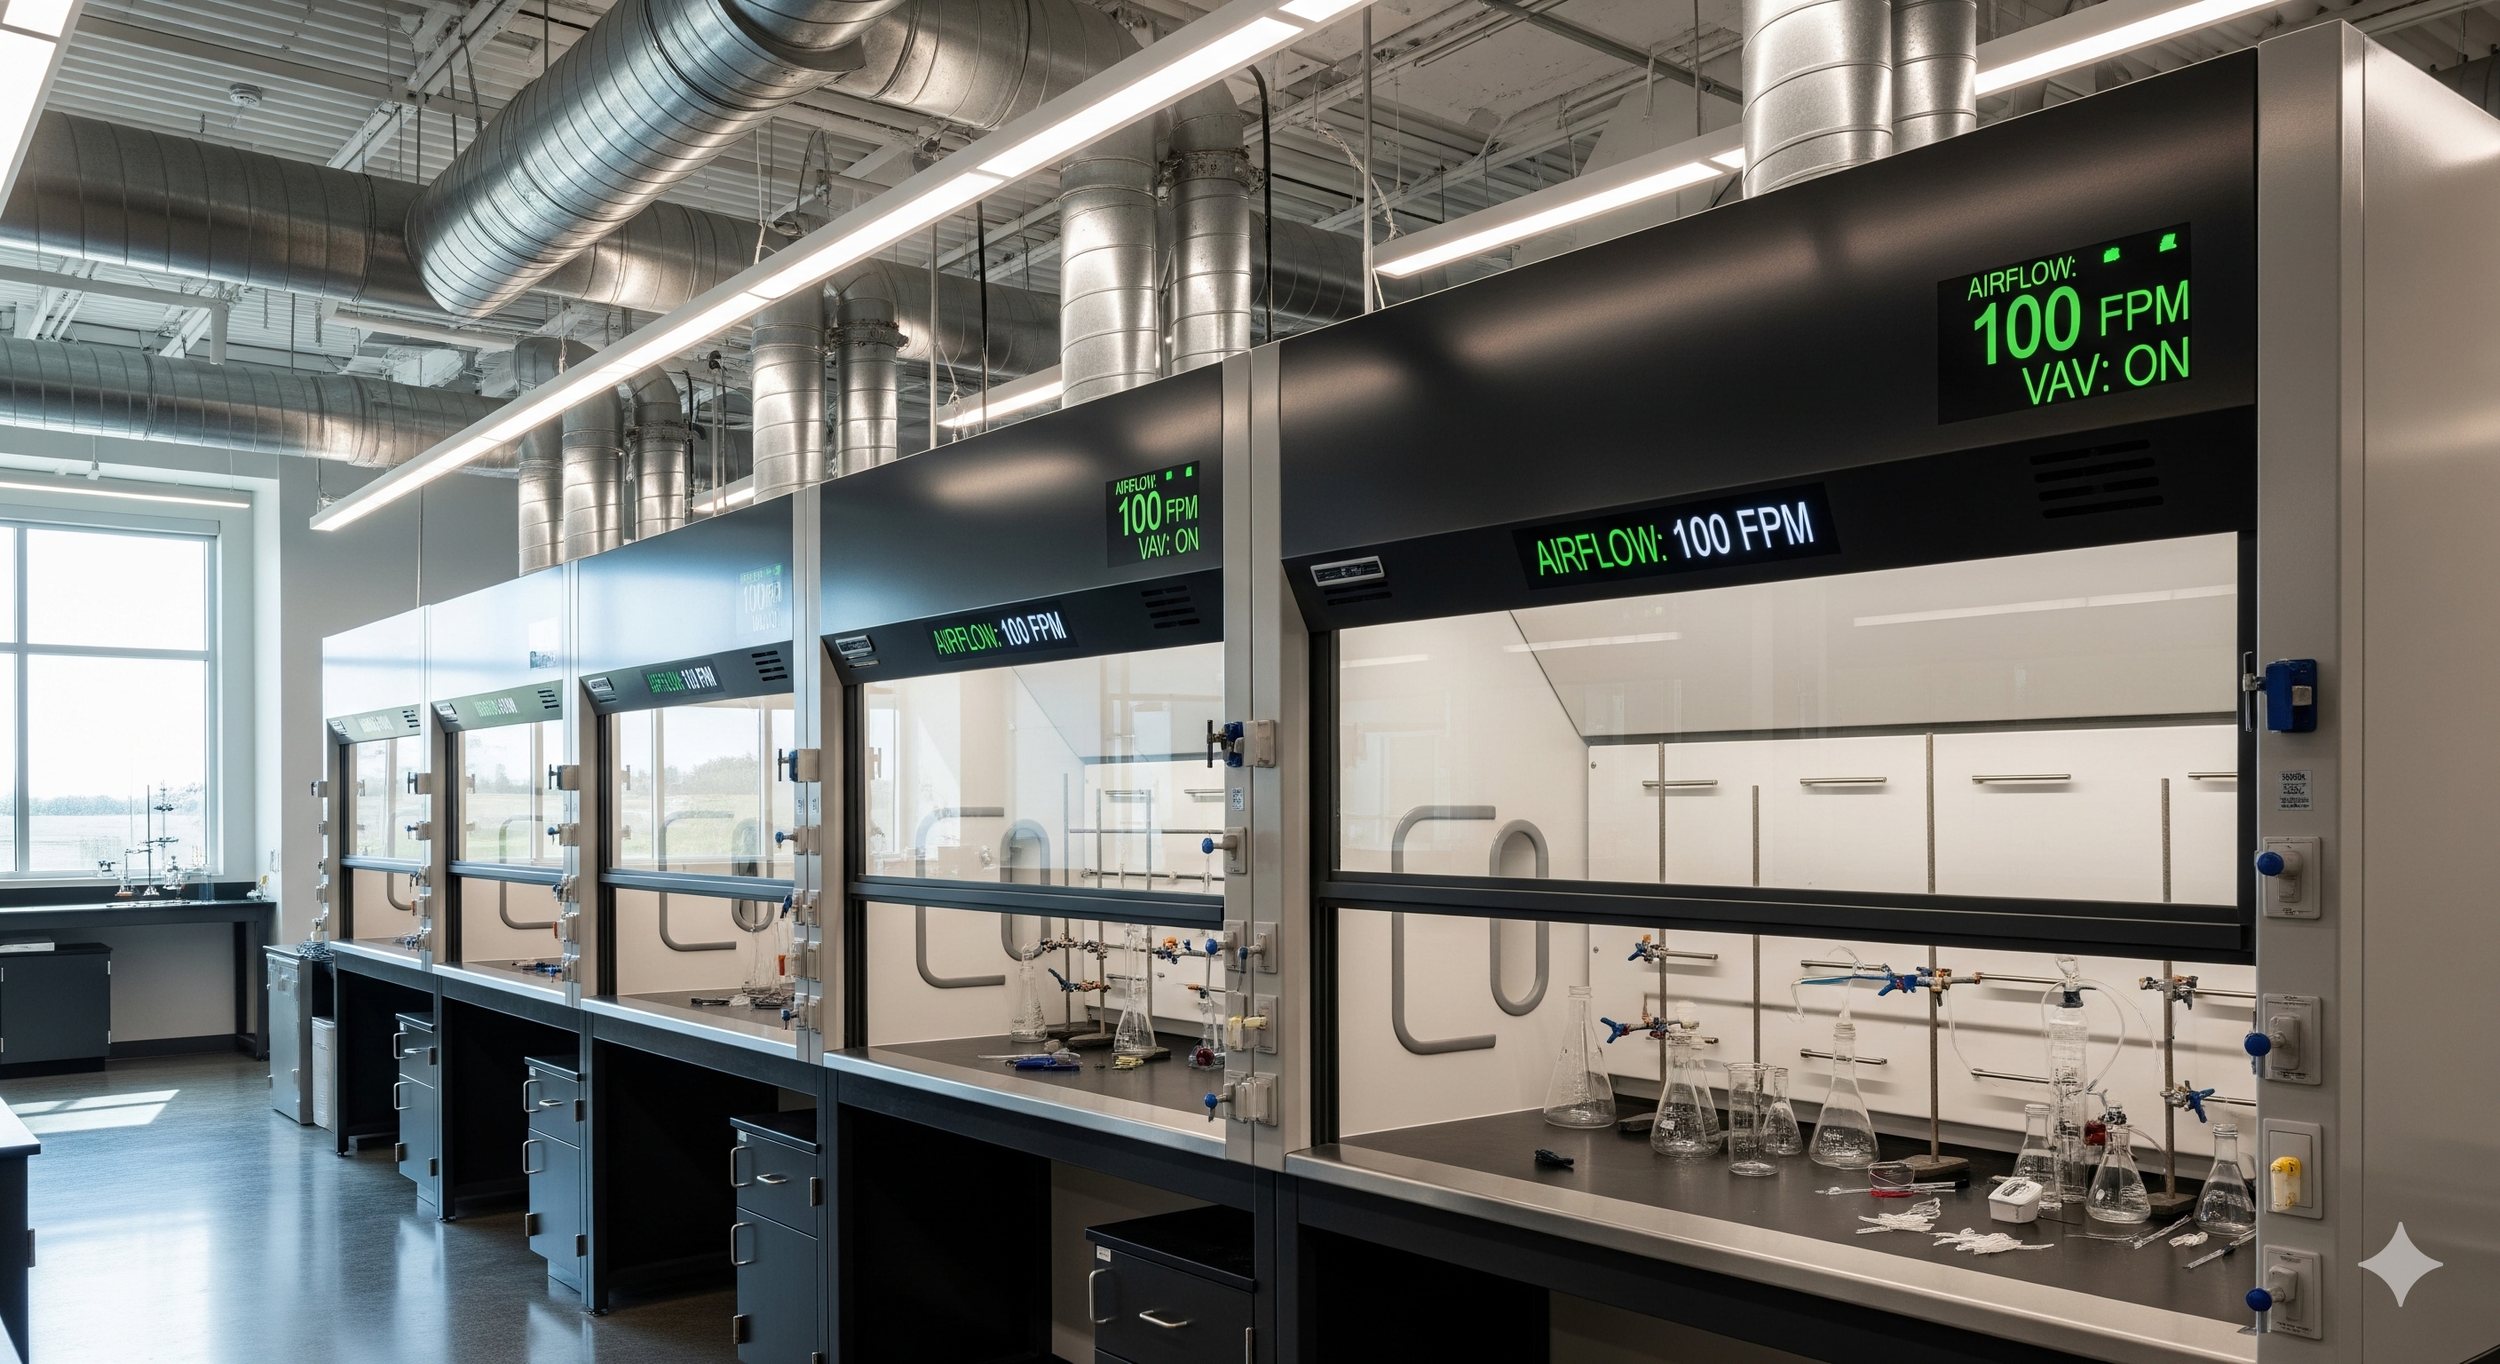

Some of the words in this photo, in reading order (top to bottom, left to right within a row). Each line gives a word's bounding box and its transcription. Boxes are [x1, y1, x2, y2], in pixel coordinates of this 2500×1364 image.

[1967, 256, 2077, 301] AIRFLOW:
[1974, 286, 2081, 365] 100
[2100, 280, 2189, 336] FPM
[2022, 353, 2109, 405] VAV:
[2124, 337, 2189, 387] ON
[1118, 490, 1161, 536] 100
[1166, 494, 1198, 523] FPM
[1138, 533, 1170, 560] VAV:
[1175, 526, 1199, 553] ON
[1537, 524, 1668, 576] AIRFLOW:
[1673, 513, 1731, 559] 100
[1736, 501, 1814, 551] FPM
[1001, 616, 1030, 646] 100
[1026, 611, 1067, 642] FPM
